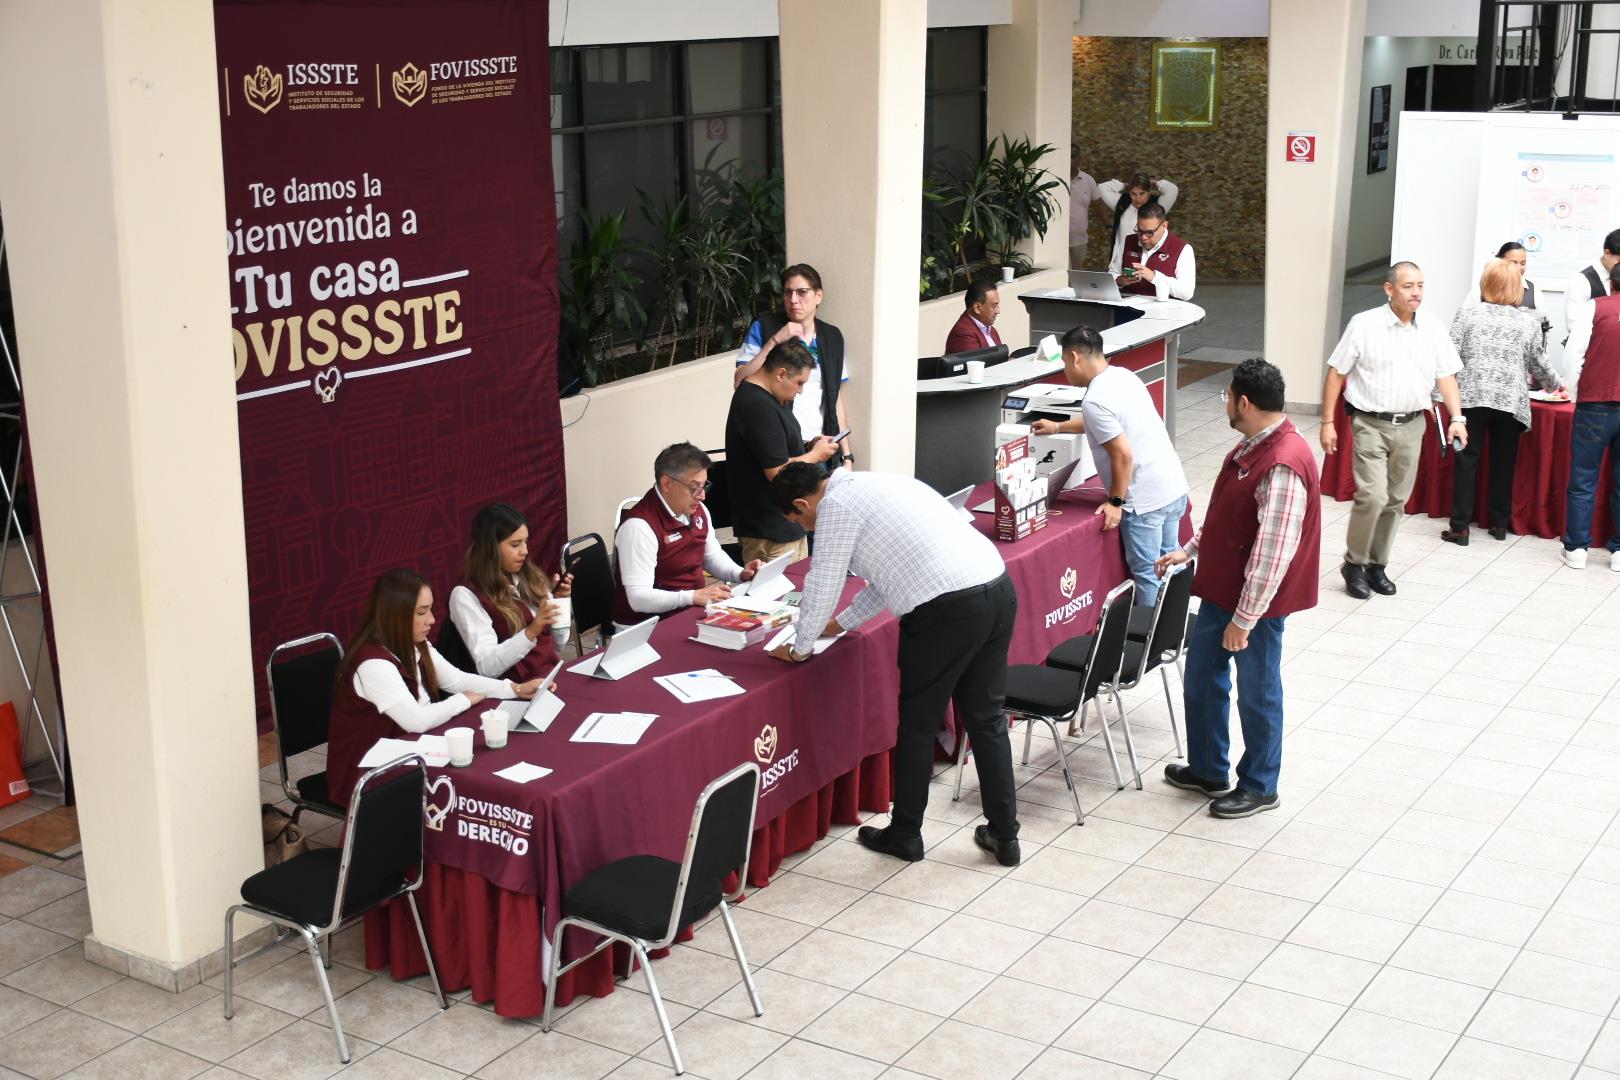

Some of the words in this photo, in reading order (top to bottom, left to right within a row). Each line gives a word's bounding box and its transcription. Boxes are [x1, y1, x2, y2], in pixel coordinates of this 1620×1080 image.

[1439, 44, 1452, 59] Dr.
[287, 63, 359, 85] ISSSTE
[430, 56, 517, 80] FOVISSSTE
[248, 182, 276, 208] Te
[283, 177, 357, 204] damos
[363, 172, 382, 198] la
[401, 209, 418, 235] a
[234, 265, 292, 314] Tu
[309, 257, 400, 301] casa
[1045, 590, 1093, 629] FOVISSSTE
[458, 795, 534, 830] FOVISSSTE
[489, 819, 498, 827] ES
[498, 820, 507, 829] TU
[458, 820, 529, 856] DERECHO
